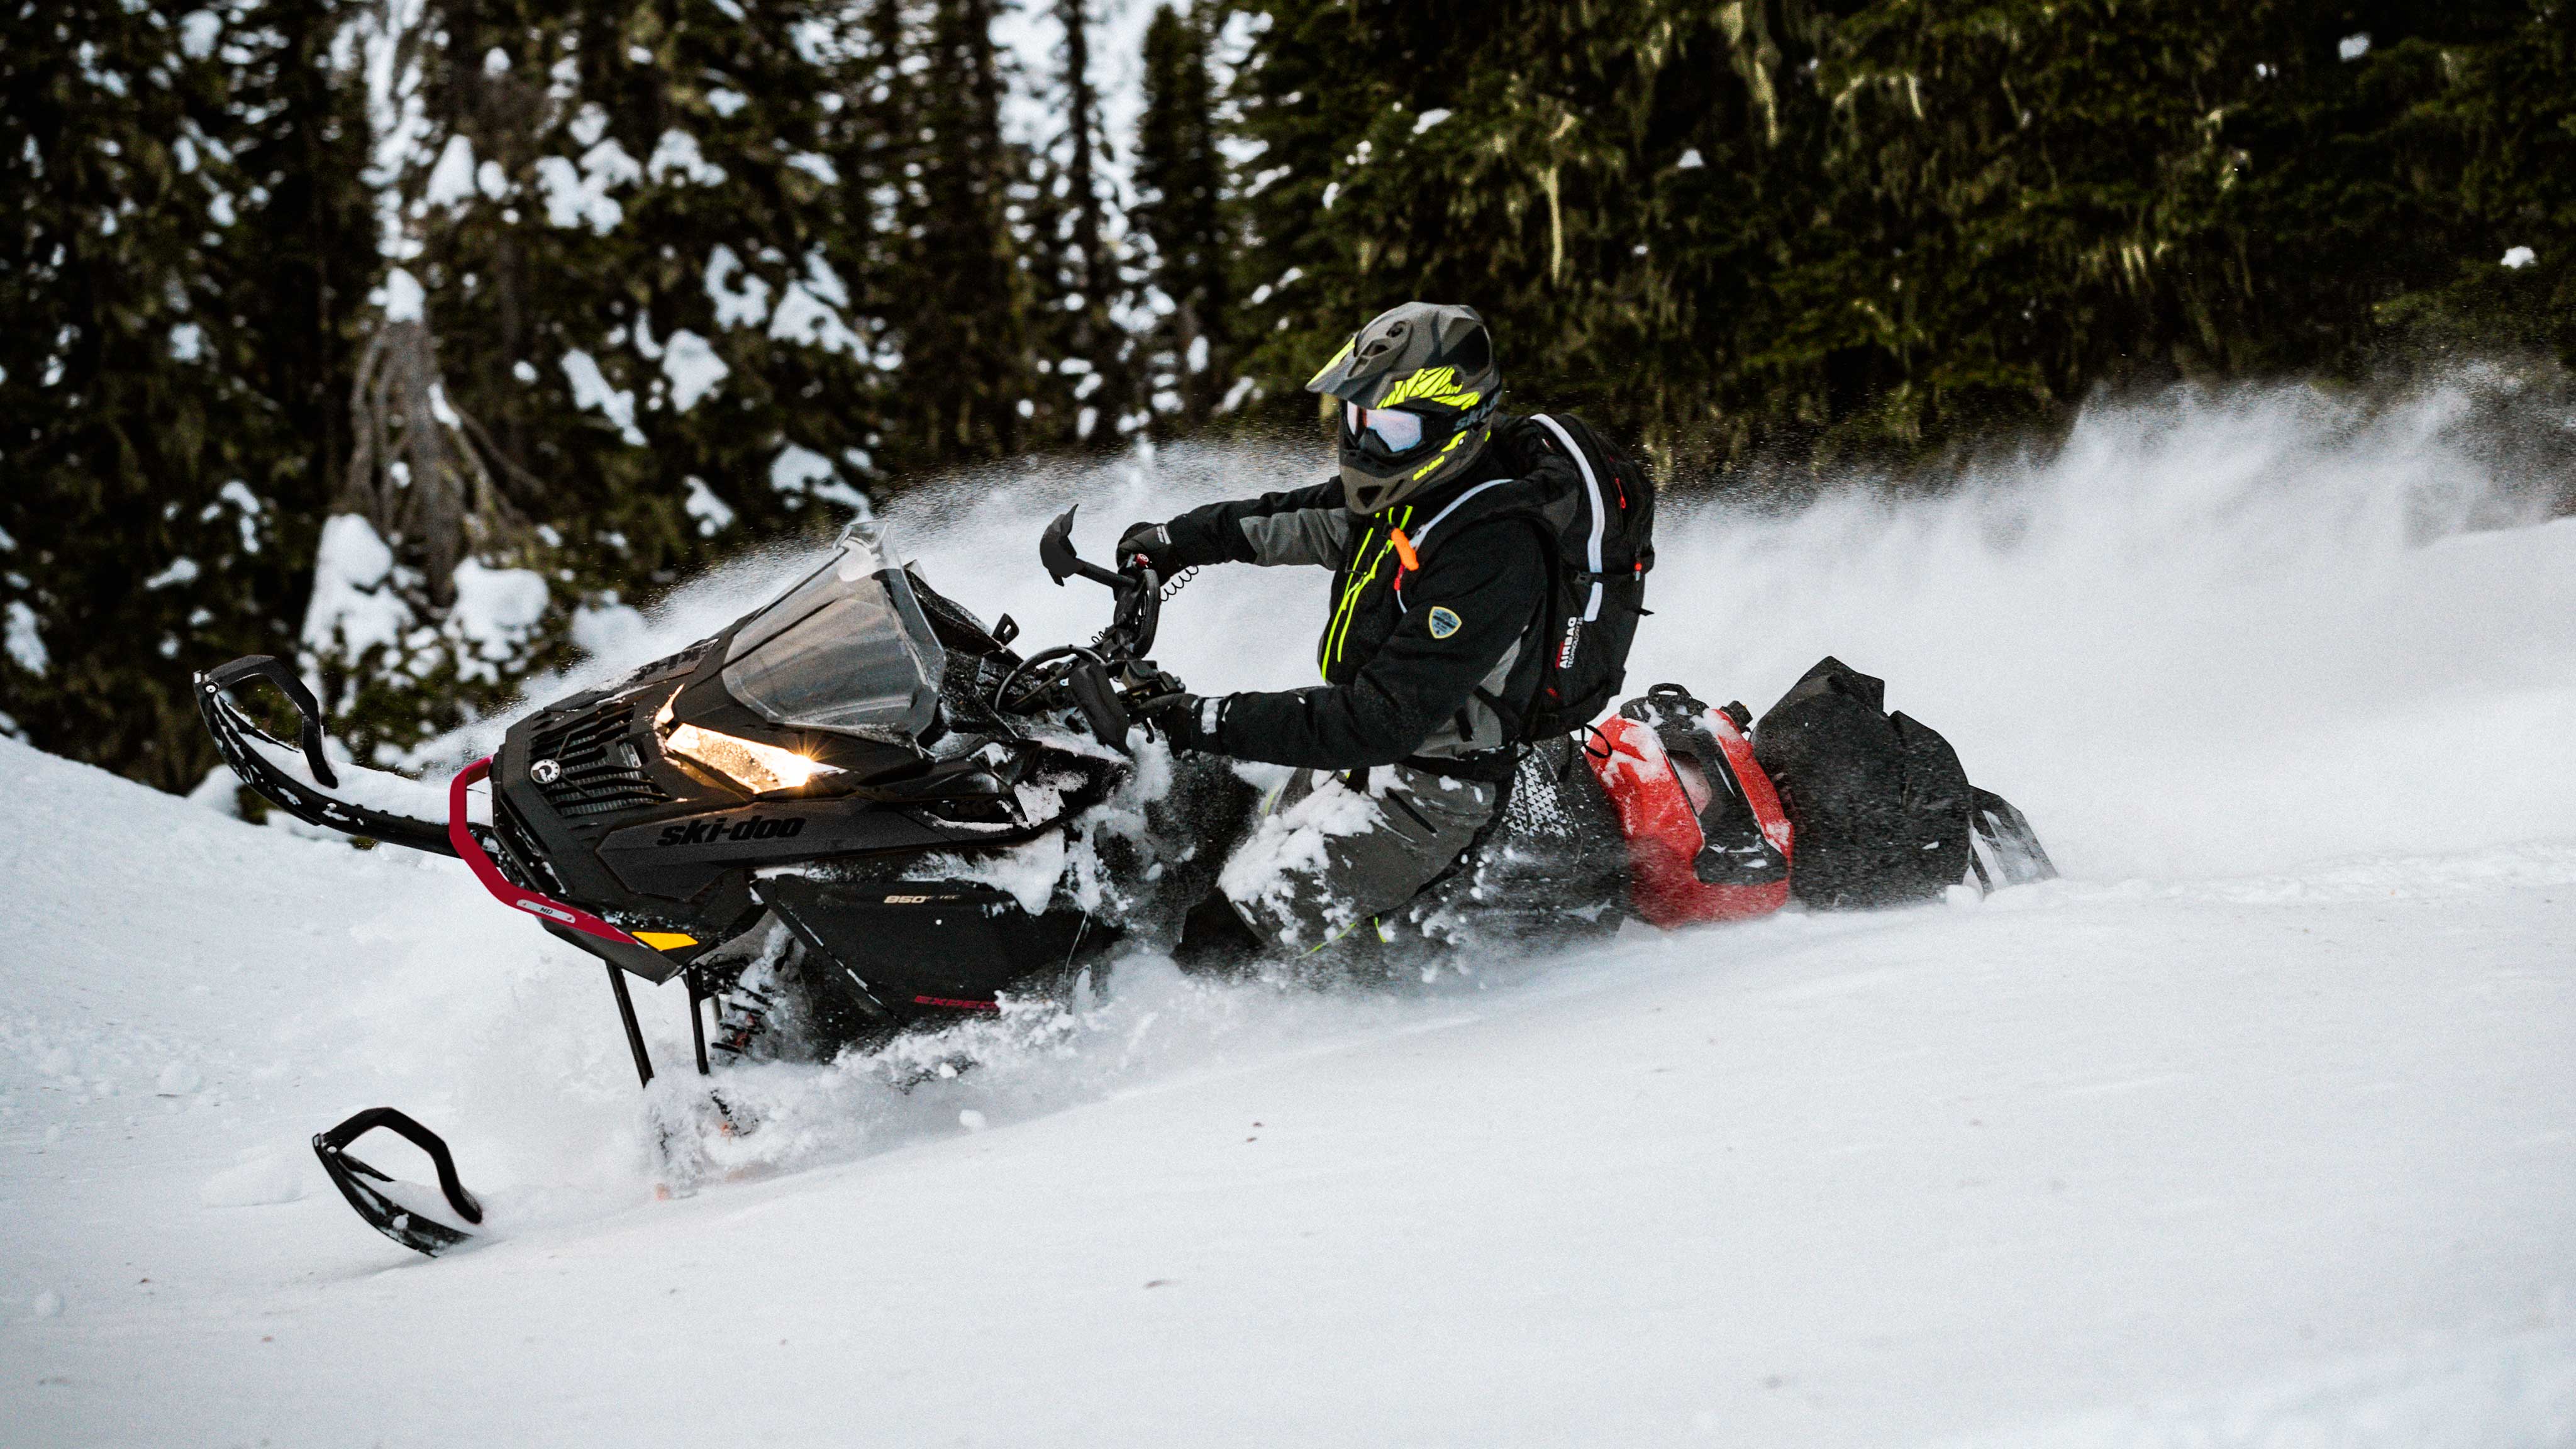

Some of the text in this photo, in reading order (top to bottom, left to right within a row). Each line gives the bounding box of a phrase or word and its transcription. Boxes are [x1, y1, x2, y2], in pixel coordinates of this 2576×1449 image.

[1559, 617, 1577, 669] AIRBAG
[657, 816, 807, 846] ski-doo
[884, 895, 927, 904] 850
